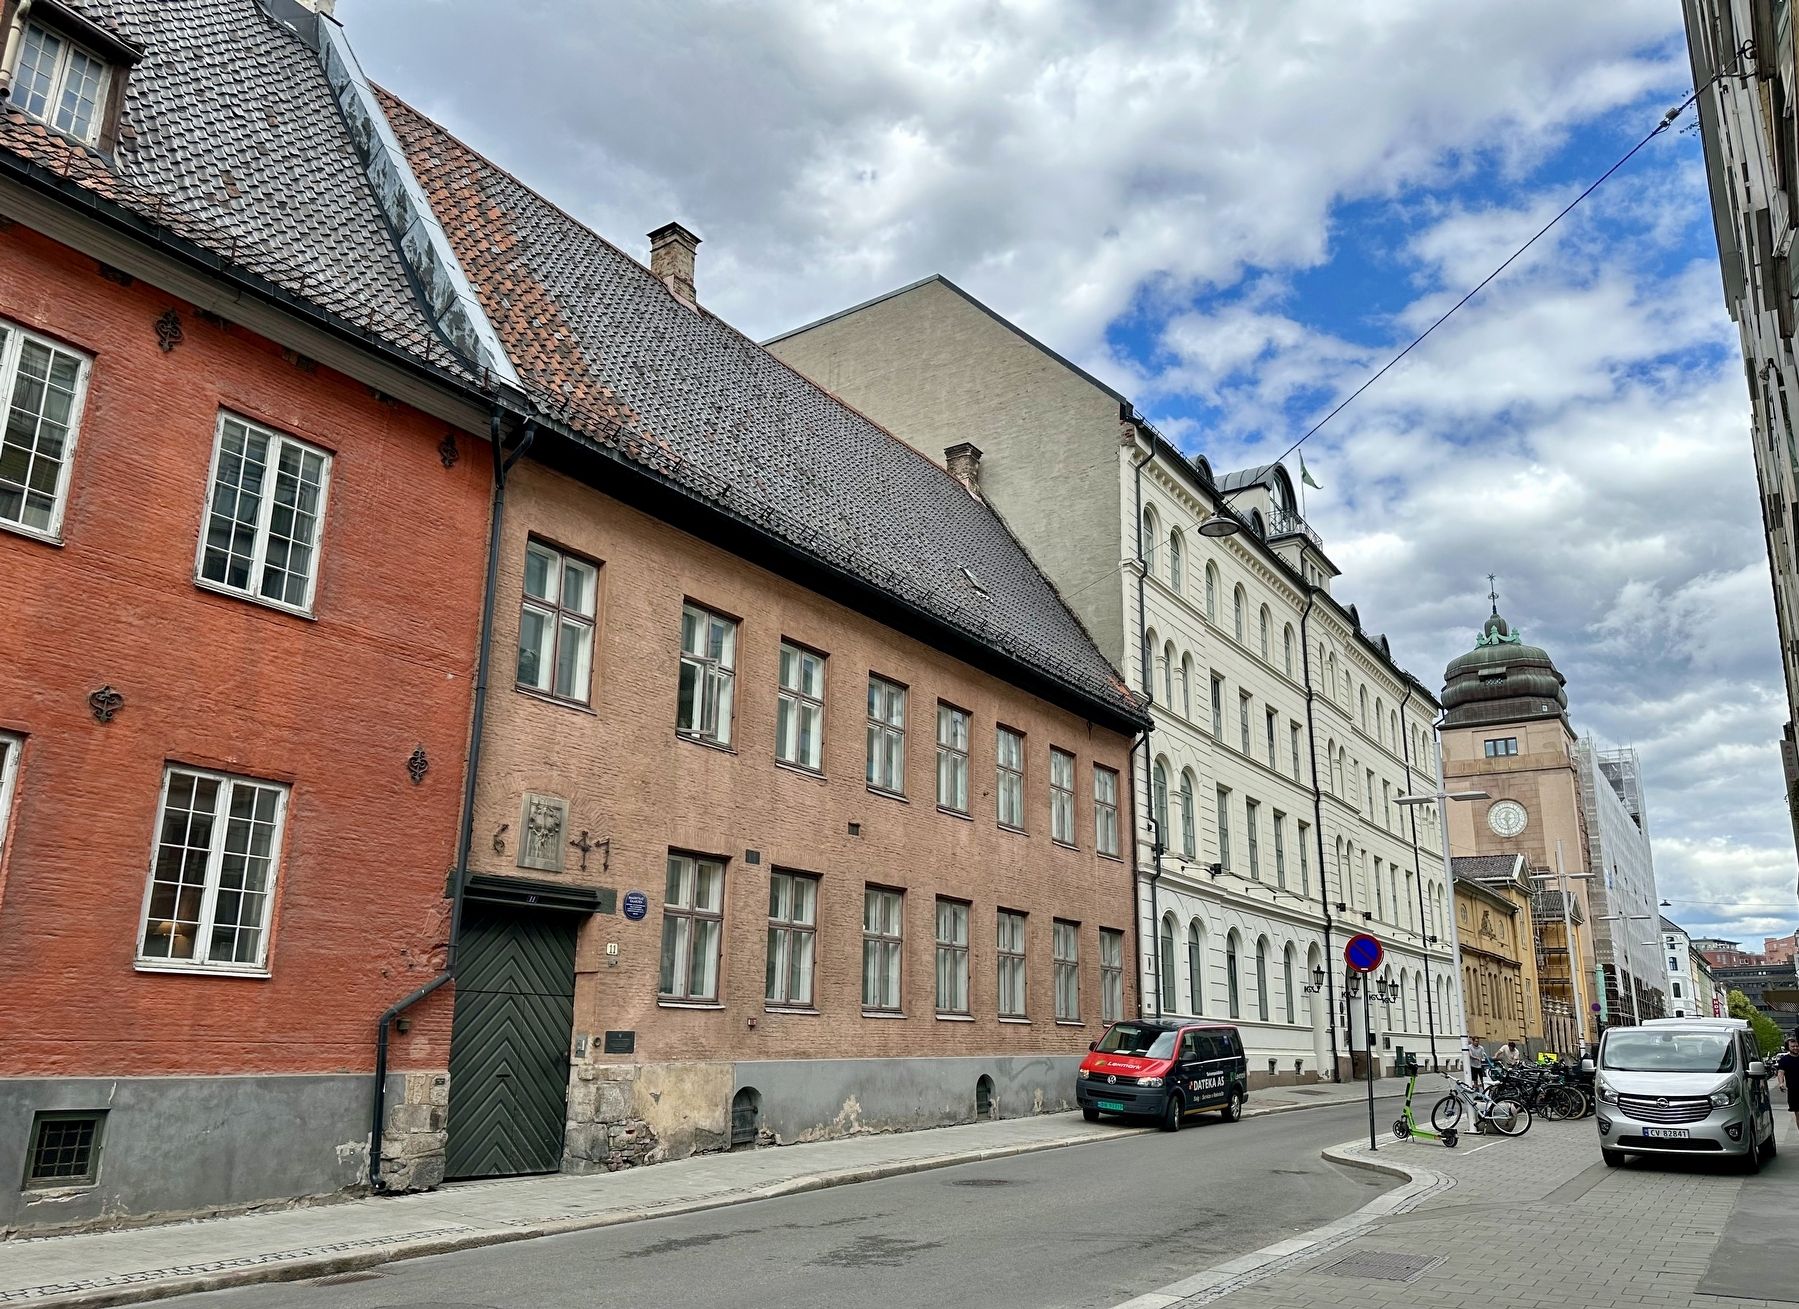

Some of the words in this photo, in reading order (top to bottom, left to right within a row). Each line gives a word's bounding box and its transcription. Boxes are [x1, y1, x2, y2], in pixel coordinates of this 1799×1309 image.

[609, 944, 616, 954] 11
[1107, 1061, 1142, 1070] Lexmark
[1193, 1077, 1217, 1091] DATEKA
[1217, 1076, 1225, 1087] AS
